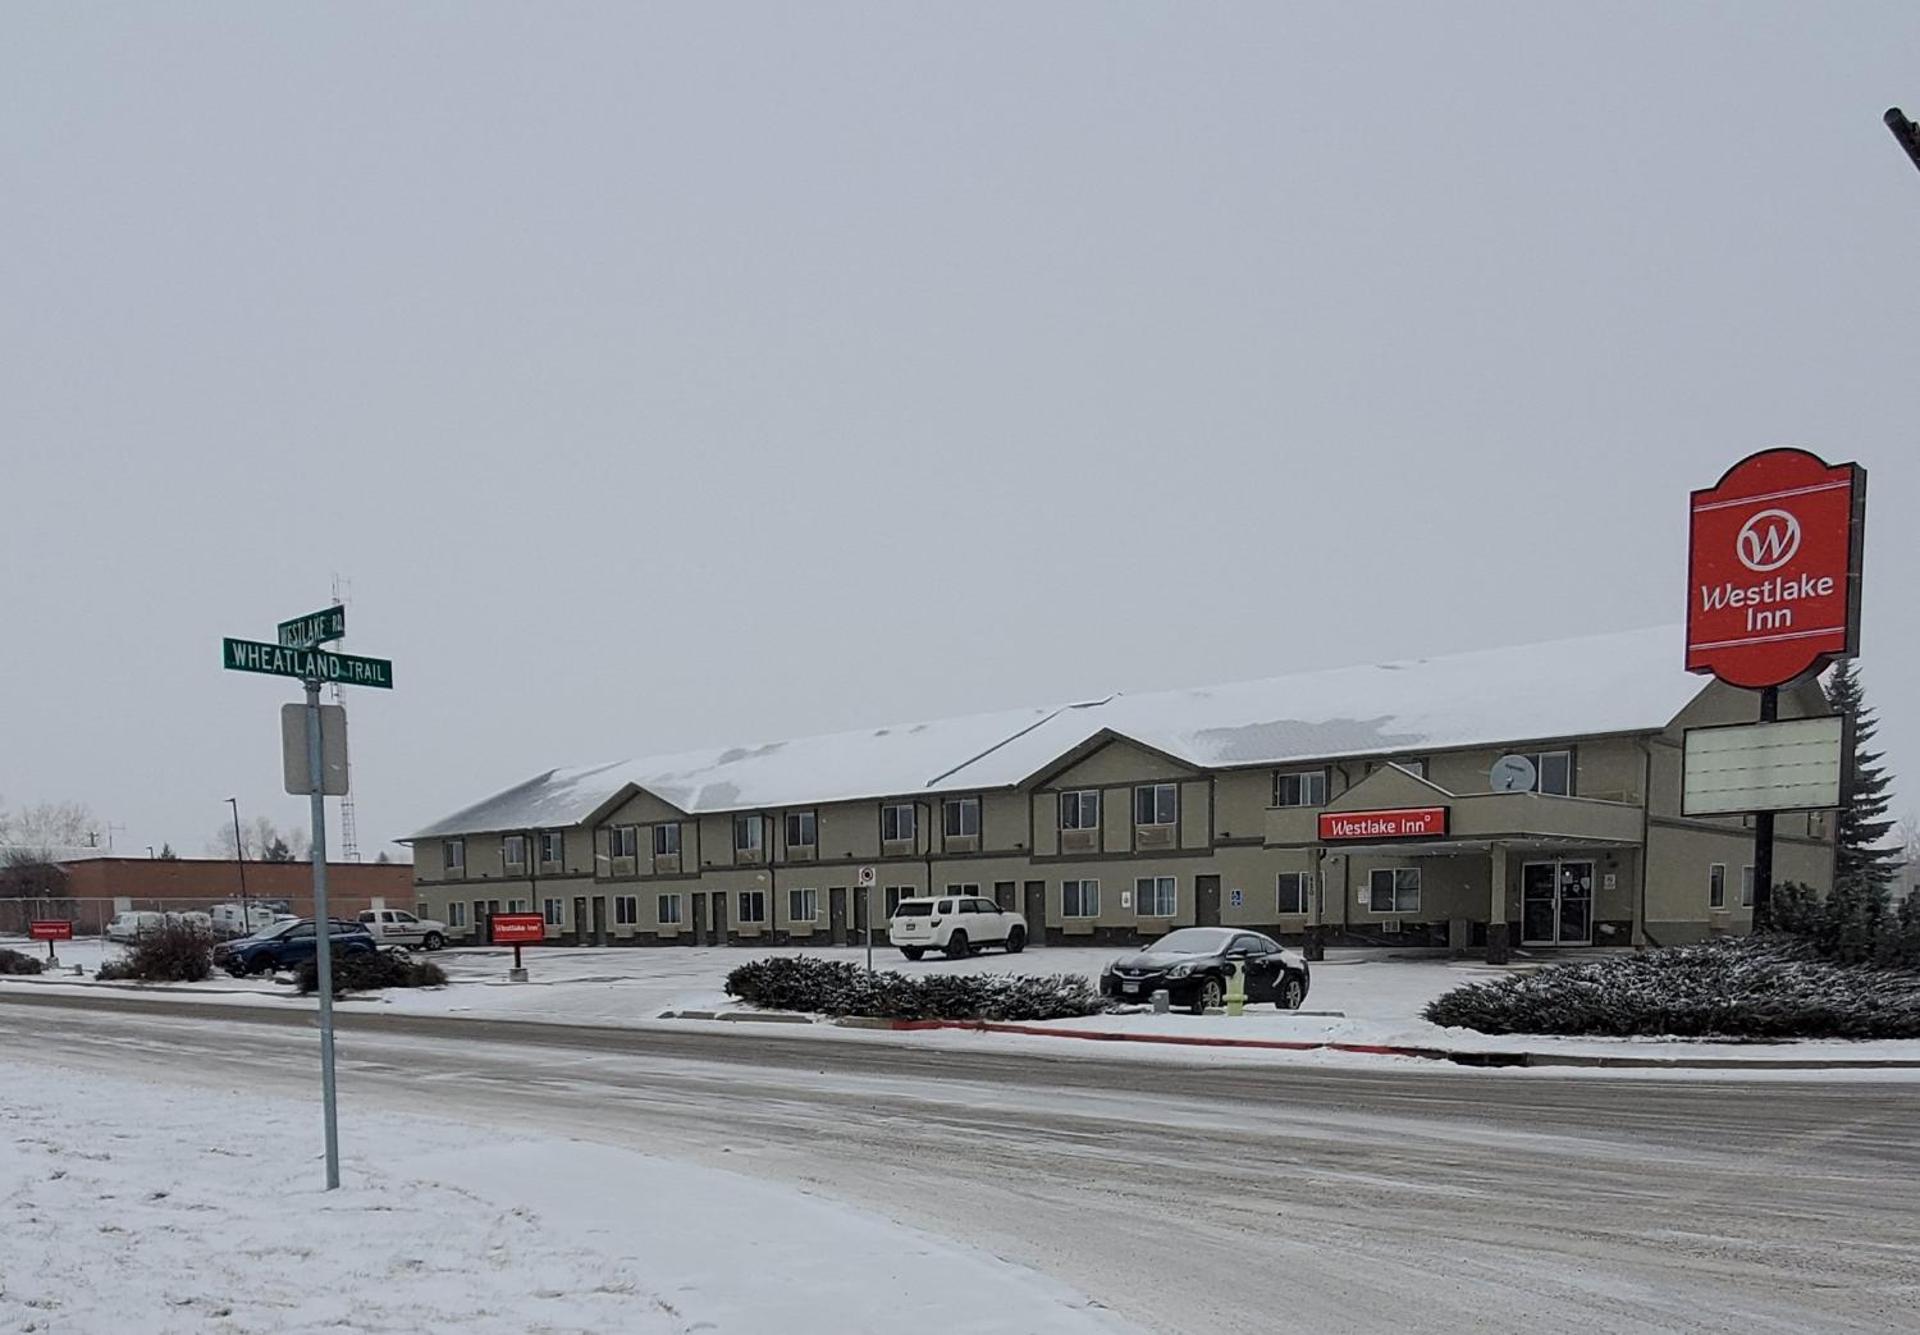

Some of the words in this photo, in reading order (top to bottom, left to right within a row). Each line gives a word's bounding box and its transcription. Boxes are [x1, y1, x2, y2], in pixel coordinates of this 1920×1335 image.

[1701, 574, 1834, 611] Westlake
[280, 616, 325, 646] WESTLAKE
[1746, 607, 1792, 631] Inn
[232, 643, 340, 678] WHEATLAND
[347, 661, 385, 682] TRAIL
[1331, 819, 1396, 836] Westlake
[1402, 818, 1424, 833] Inn
